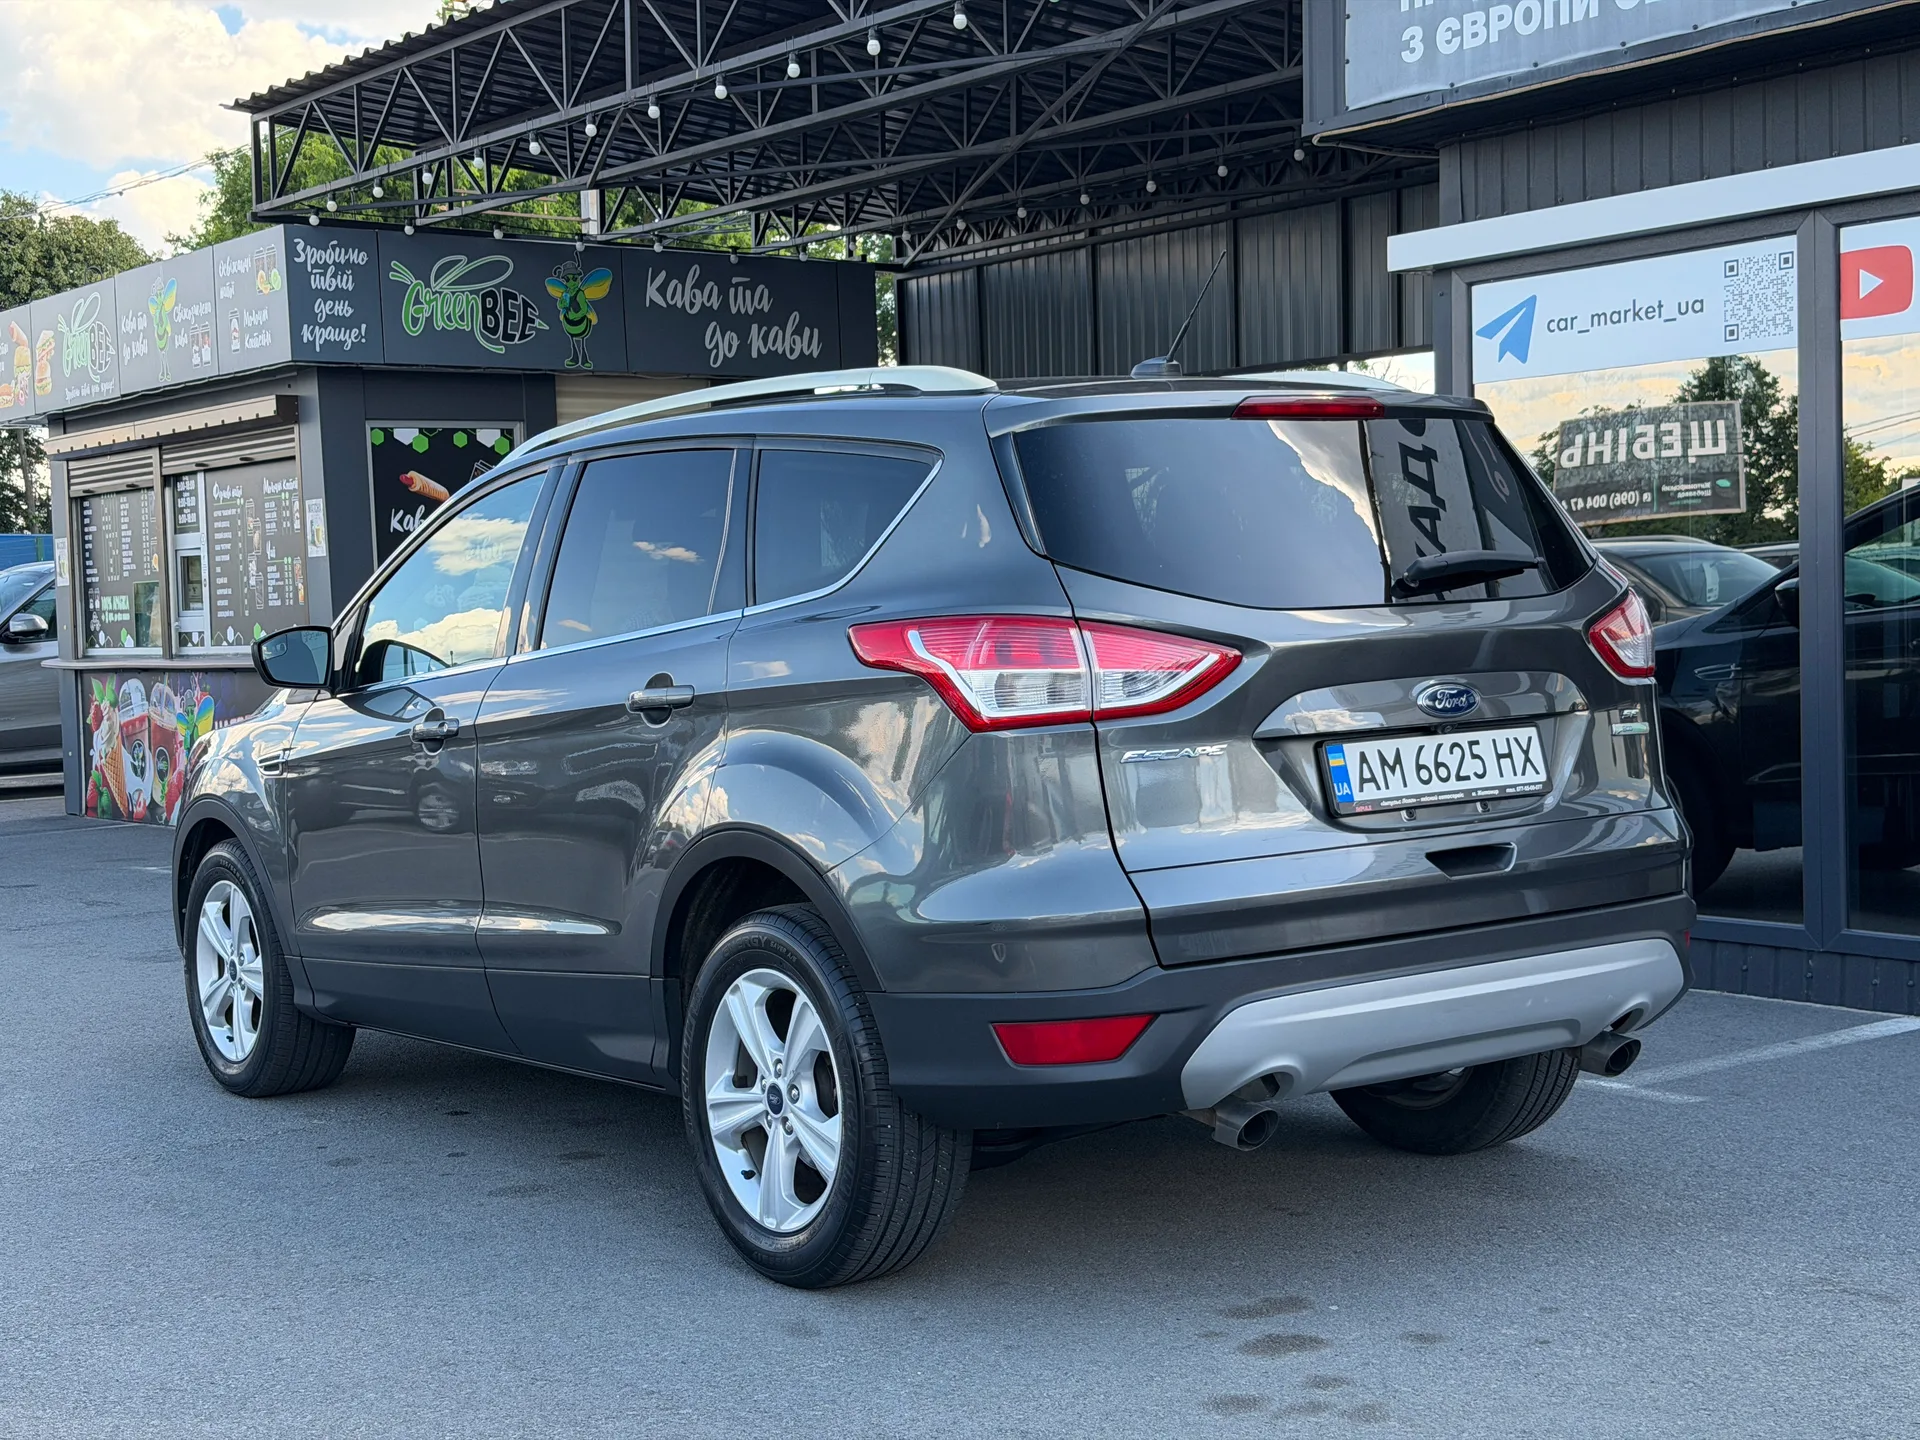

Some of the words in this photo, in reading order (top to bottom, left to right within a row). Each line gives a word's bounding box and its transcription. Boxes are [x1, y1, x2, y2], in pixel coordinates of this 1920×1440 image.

[1400, 25, 1424, 64] З
[293, 237, 368, 273] Зробимо
[310, 265, 354, 292] твій
[645, 263, 722, 315] Кава
[729, 276, 773, 316] та
[314, 296, 354, 323] день
[1546, 297, 1705, 334] car_market_ua
[301, 323, 367, 353] краще!
[704, 321, 740, 368] до
[747, 311, 822, 360] кави
[1435, 690, 1468, 709] Ford
[1120, 744, 1228, 764] ESCAPE
[1358, 747, 1408, 793] AM
[1415, 740, 1487, 785] 6625
[1491, 736, 1541, 778] HX
[1334, 782, 1351, 797] UA
